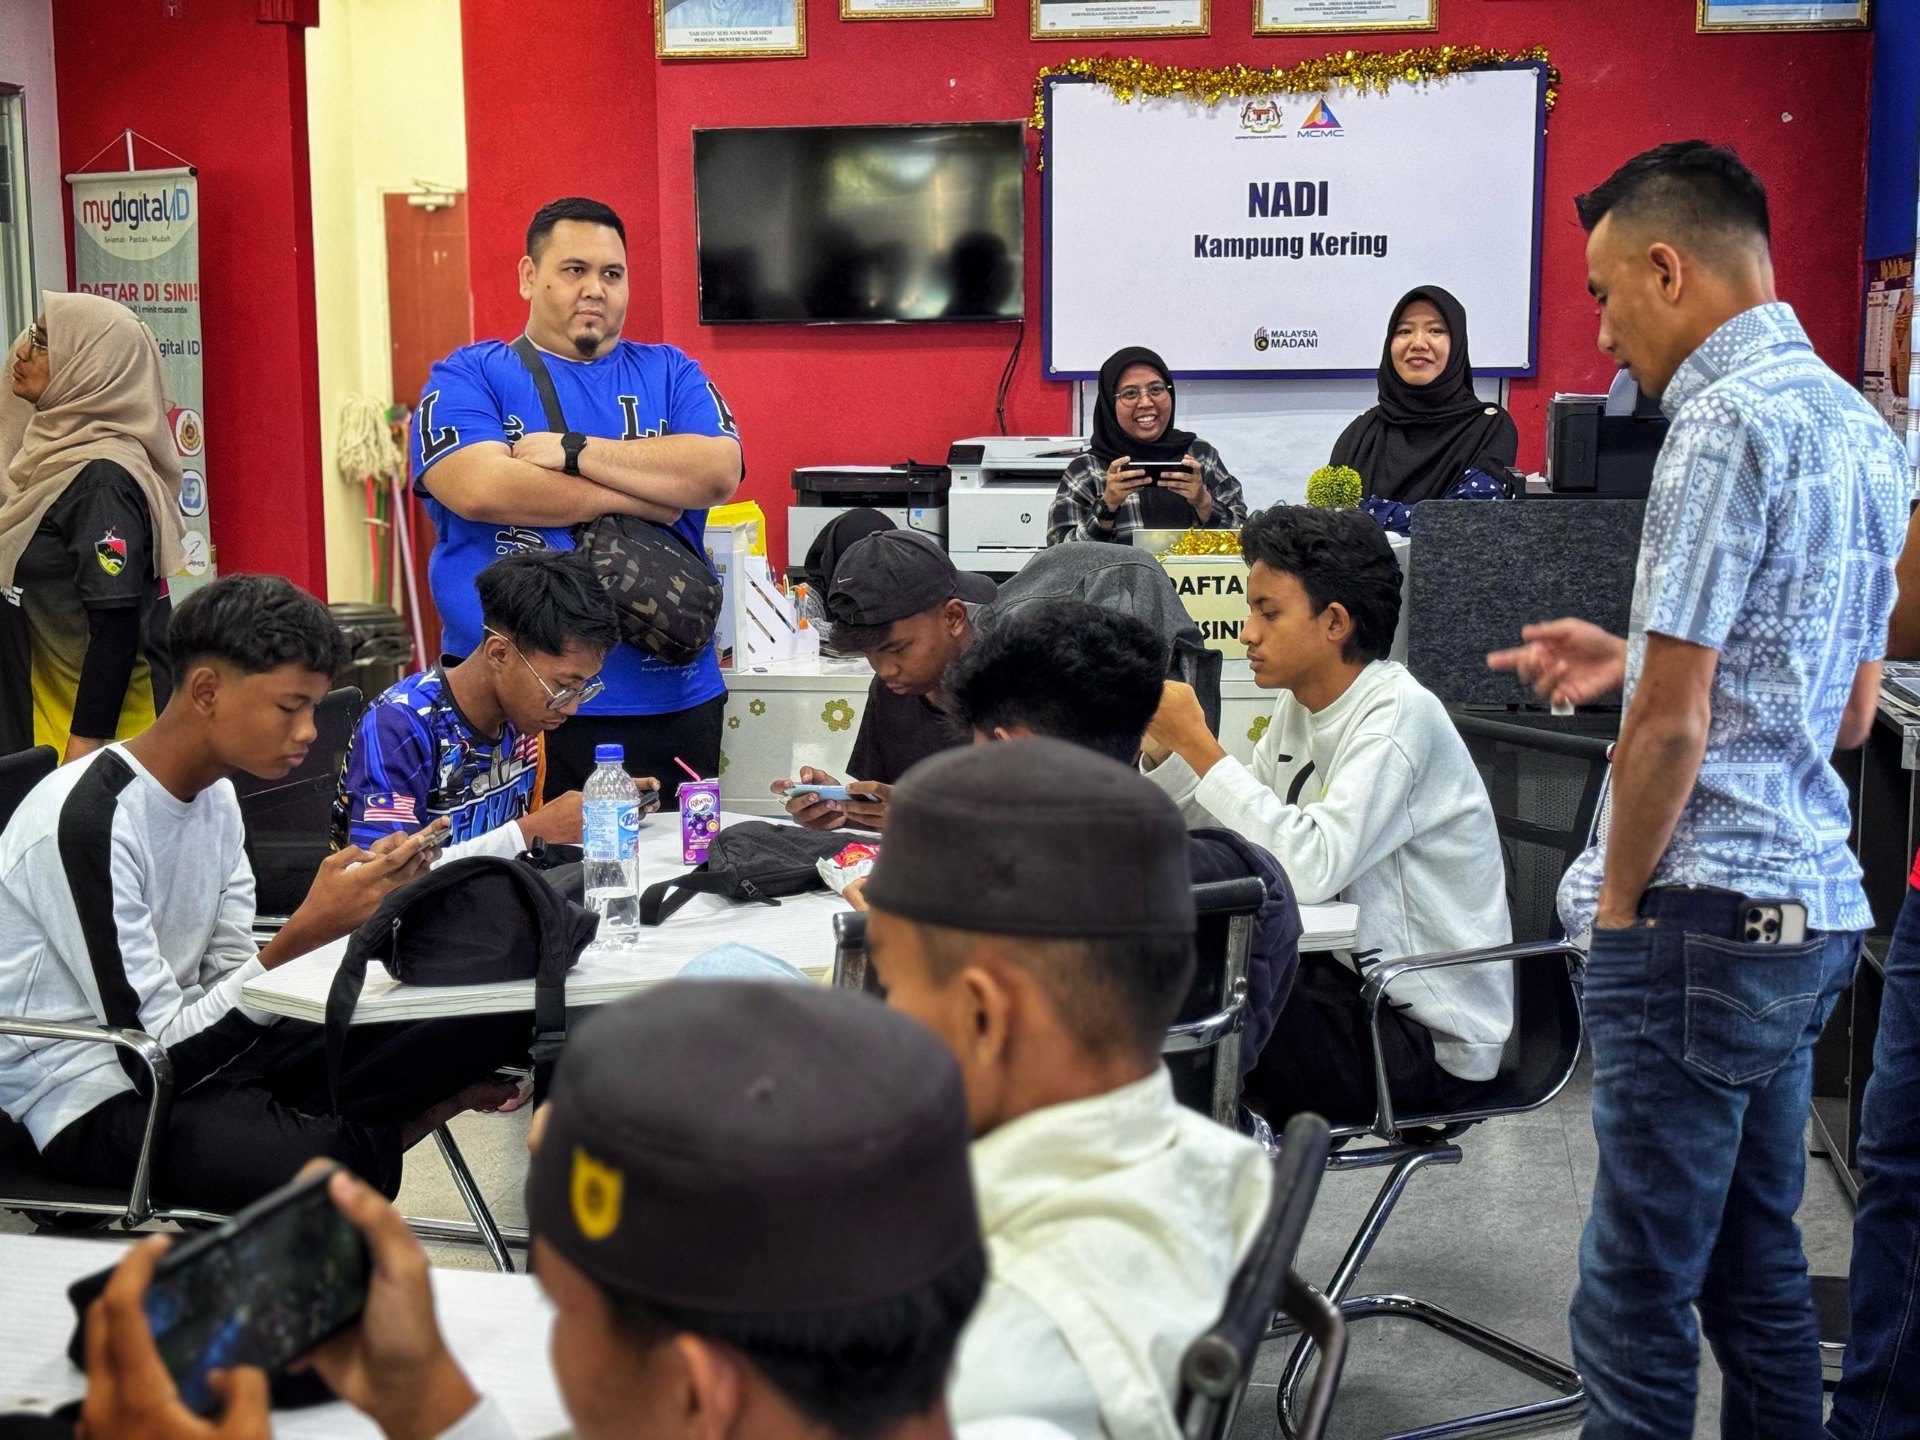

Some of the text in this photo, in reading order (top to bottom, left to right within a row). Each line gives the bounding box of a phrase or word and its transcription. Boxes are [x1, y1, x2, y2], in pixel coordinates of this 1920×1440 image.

[1297, 129, 1345, 138] MCMC
[1248, 181, 1329, 218] NADI
[1193, 231, 1388, 260] Kampung Kering
[143, 284, 160, 302] DI
[163, 283, 198, 302] SINI!
[1271, 330, 1318, 338] MALAYSIA
[187, 340, 200, 355] ID
[1270, 338, 1318, 348] MADANI
